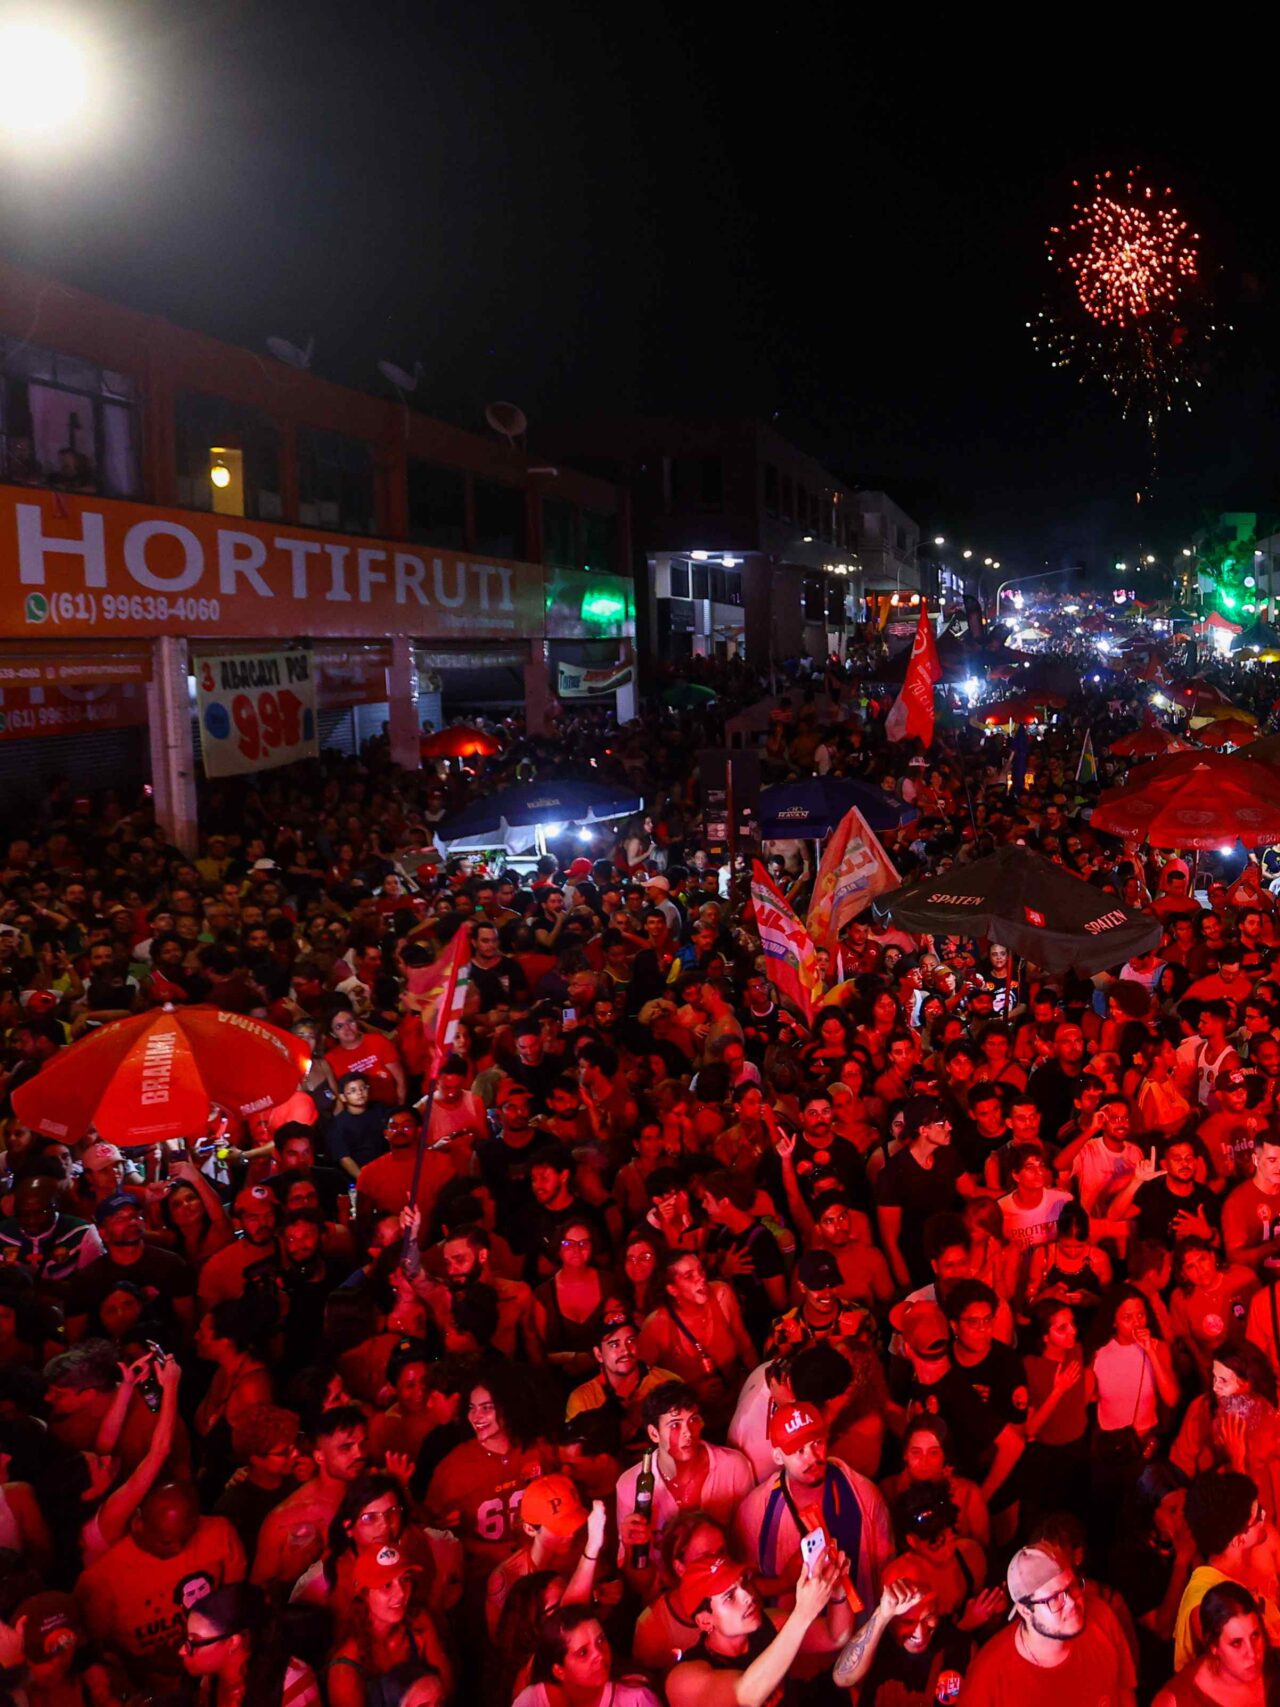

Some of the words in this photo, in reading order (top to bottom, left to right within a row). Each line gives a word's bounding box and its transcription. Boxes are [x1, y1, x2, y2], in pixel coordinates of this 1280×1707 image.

[16, 504, 513, 611] HORTIFRUTI
[51, 592, 97, 624] (61)
[102, 596, 220, 621] 99638-4060
[202, 662, 216, 692] 3
[927, 893, 985, 907] SPATEN
[1084, 909, 1128, 936] SPATEN
[141, 1031, 176, 1105] BRAHMA
[785, 1414, 814, 1434] LULA
[549, 1497, 562, 1515] P
[136, 1611, 183, 1640] LULA
